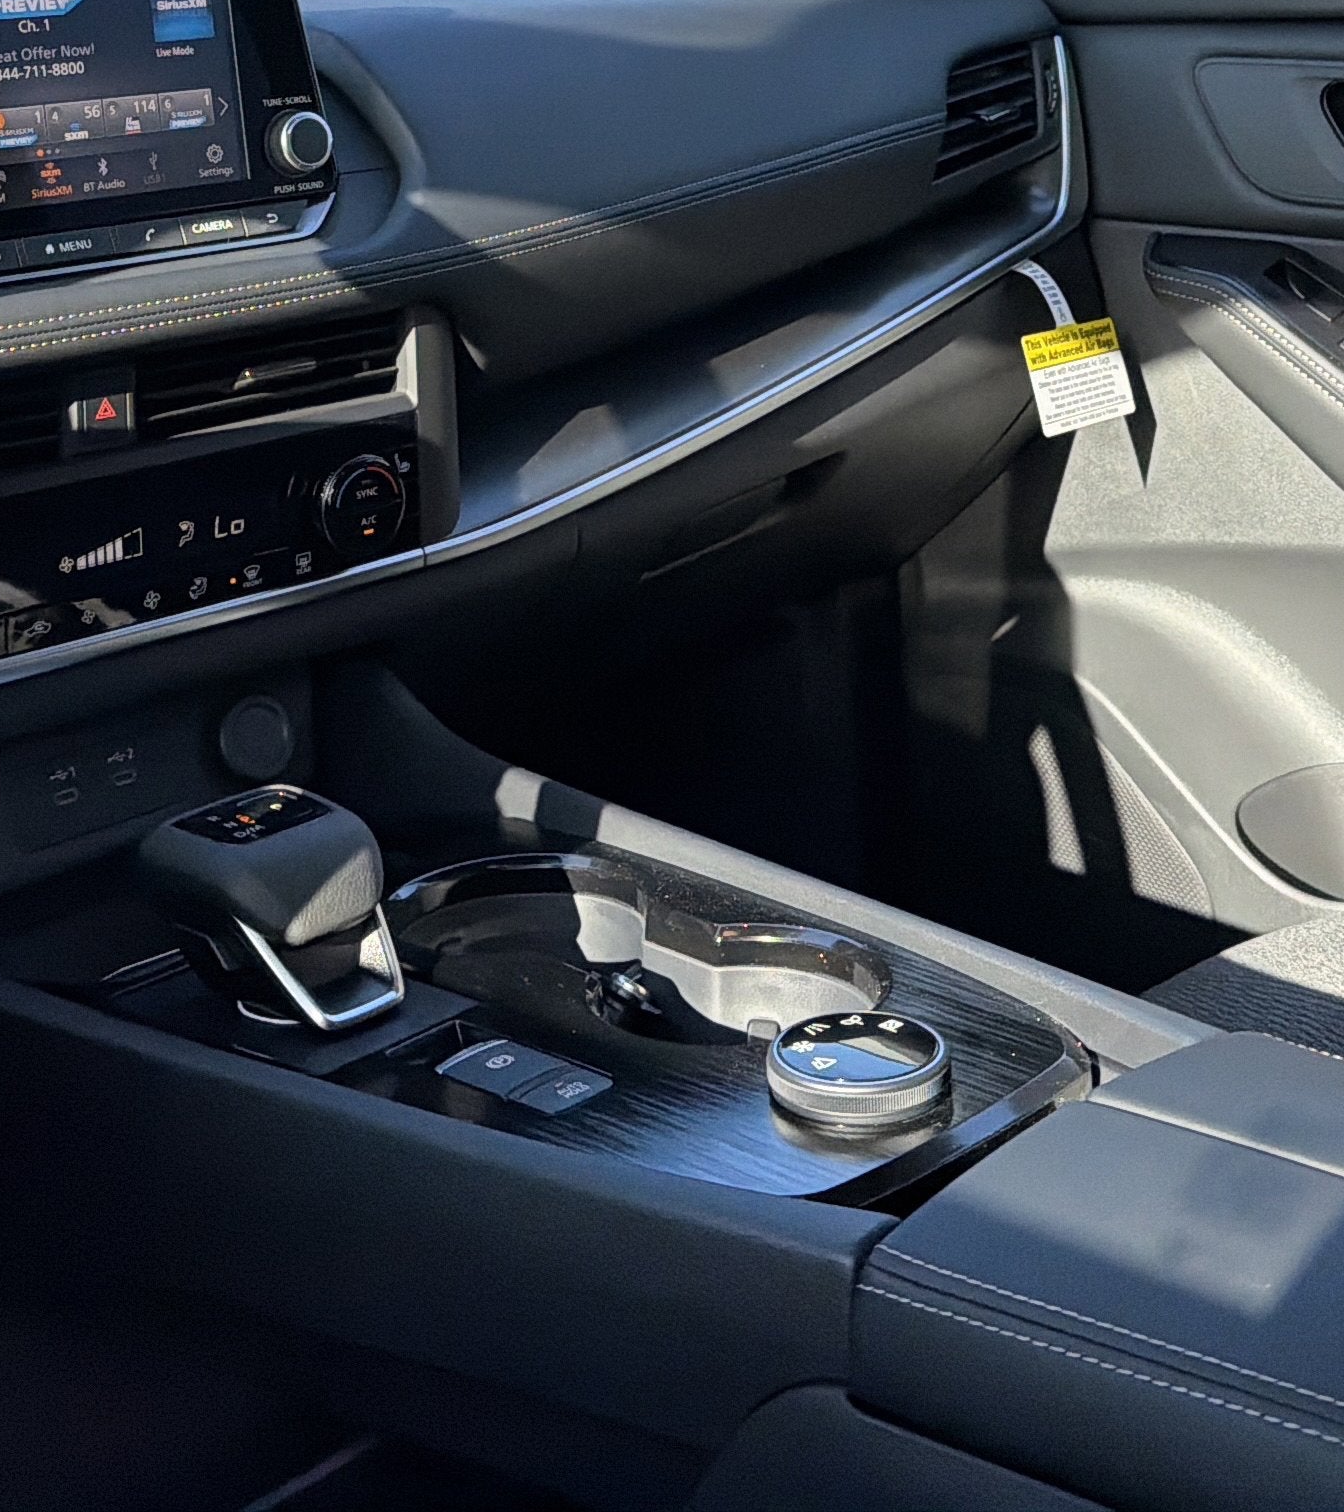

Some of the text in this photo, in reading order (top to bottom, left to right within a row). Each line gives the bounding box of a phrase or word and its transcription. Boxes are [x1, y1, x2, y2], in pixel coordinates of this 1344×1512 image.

[18, 18, 51, 34] Ch. 1
[20, 45, 57, 62] Offer
[59, 42, 95, 59] Now!
[133, 99, 157, 115] 114
[163, 98, 172, 109] 6
[203, 93, 210, 106] 1
[34, 110, 42, 124] 1
[83, 104, 101, 120] 56
[64, 130, 89, 142] sxm
[198, 165, 235, 180] Settings
[31, 184, 73, 200] SiriusXM
[82, 178, 126, 193] BT Audio
[273, 180, 325, 195] PUSH SOUND
[190, 217, 235, 235] CAMERA
[58, 238, 93, 255] MENU
[1024, 337, 1043, 352] This
[1042, 331, 1070, 348] Vehicle
[1077, 322, 1112, 340] Equipped
[1030, 338, 1116, 366] with Advanced Air Bags
[354, 484, 380, 502] SYNC
[213, 514, 246, 540] Lo
[359, 513, 377, 528] A/C
